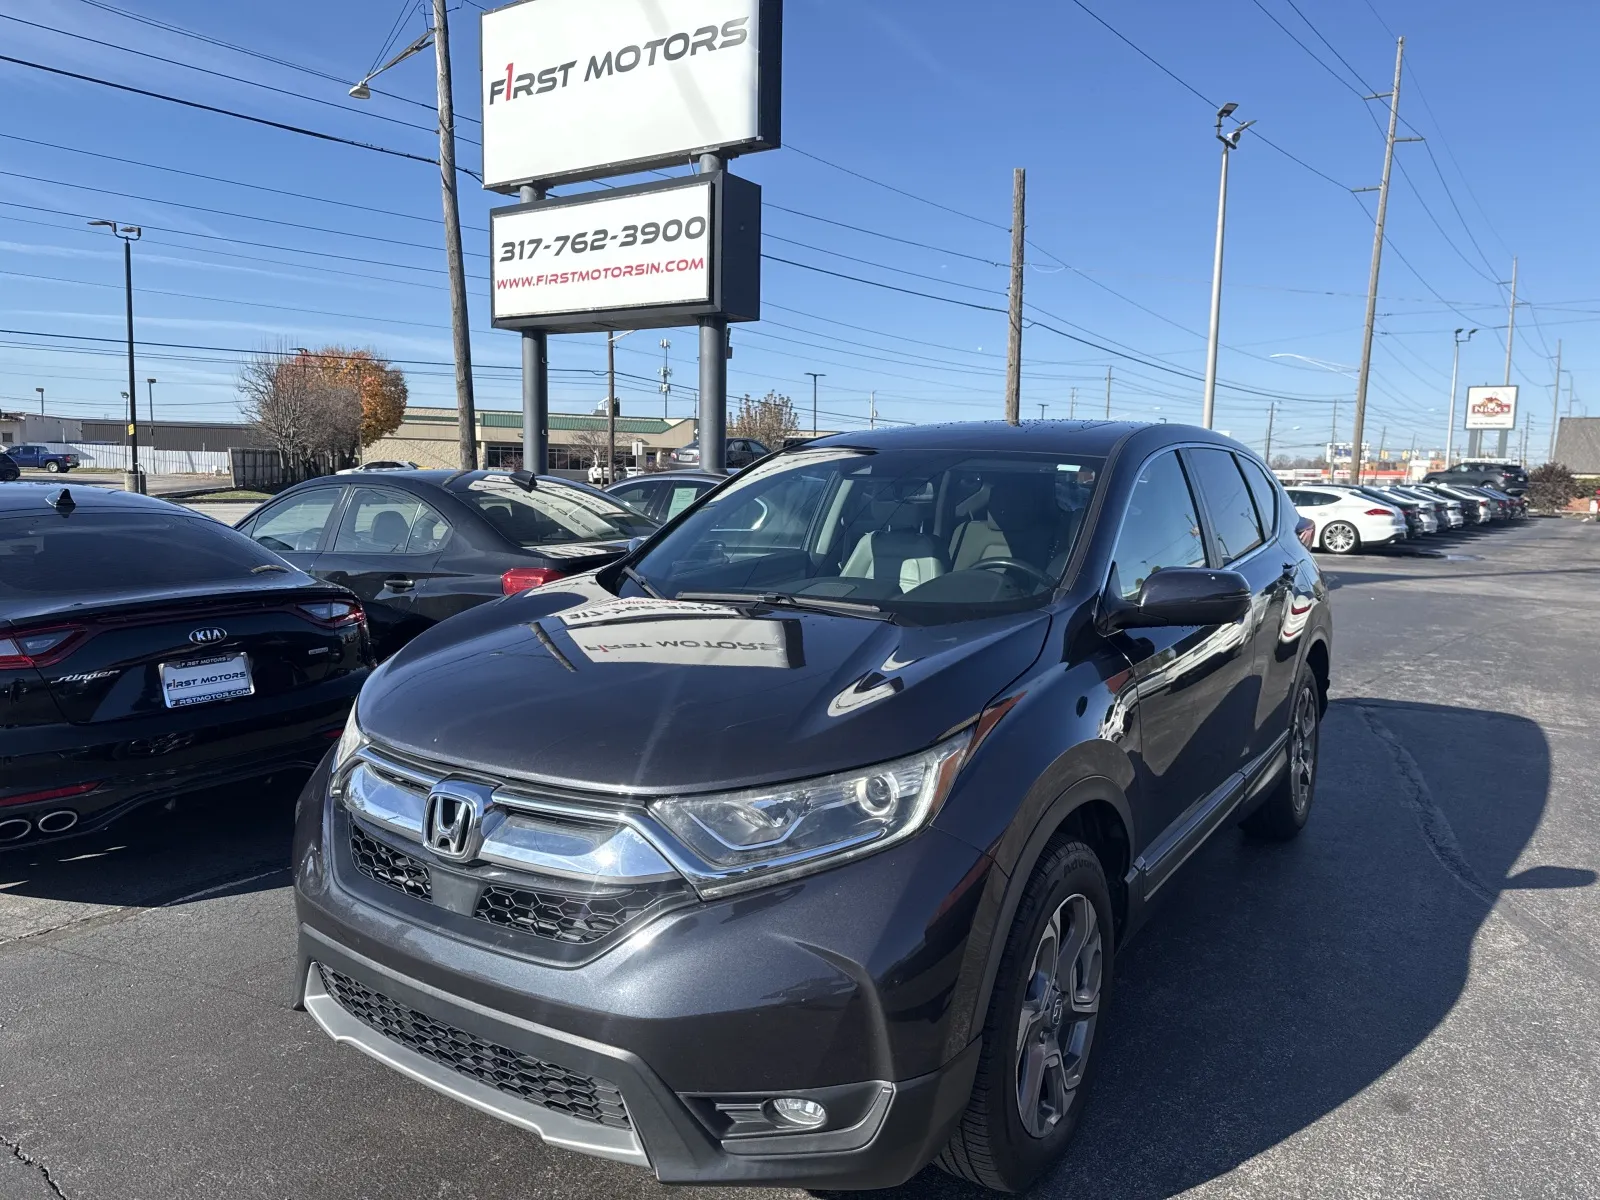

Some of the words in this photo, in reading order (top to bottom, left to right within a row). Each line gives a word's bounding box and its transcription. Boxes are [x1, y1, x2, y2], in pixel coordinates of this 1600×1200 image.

[583, 16, 749, 82] MOTORS
[499, 216, 706, 262] 317-762-3900
[496, 257, 704, 290] WWW.FIRSTMOTORSIN.COM
[196, 629, 222, 642] KIA
[200, 656, 227, 665] MOTORS
[200, 671, 246, 684] MOTORS
